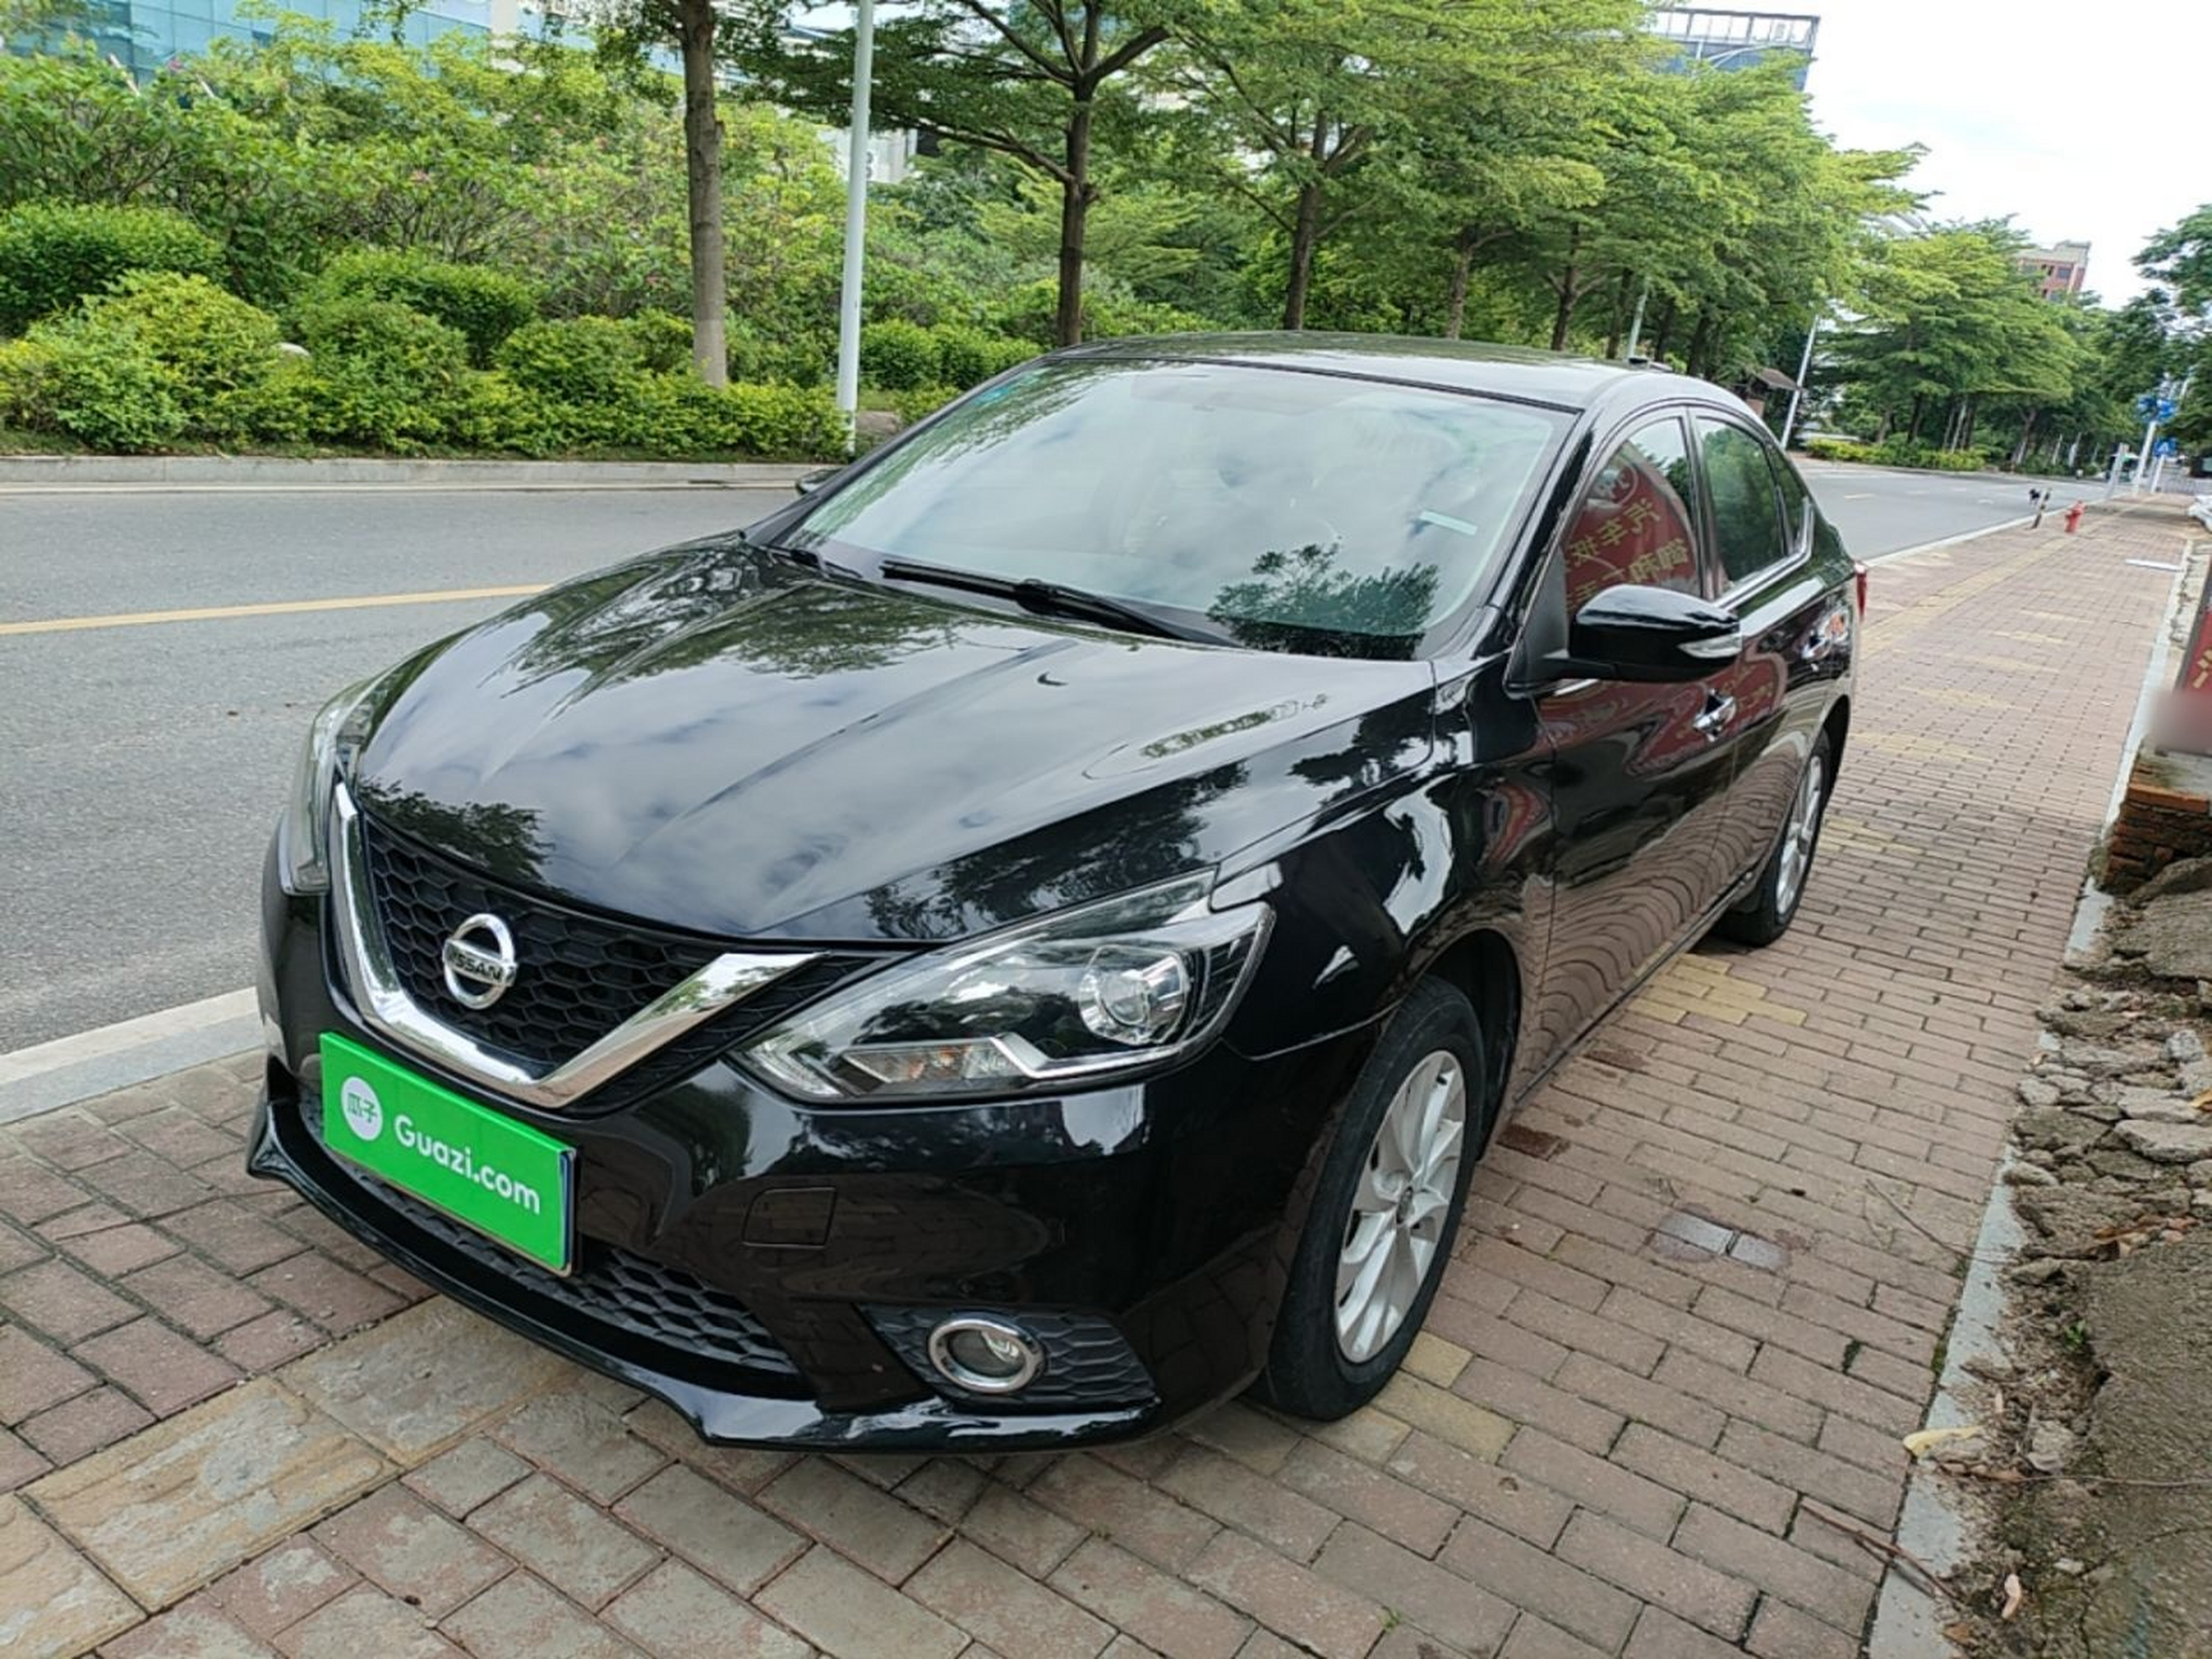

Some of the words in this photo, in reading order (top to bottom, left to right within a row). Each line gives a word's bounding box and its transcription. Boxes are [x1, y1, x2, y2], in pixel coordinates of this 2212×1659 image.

[446, 943, 504, 981] NISSAN
[346, 1092, 379, 1124] 瓜子
[393, 1114, 540, 1214] Guazi.com
